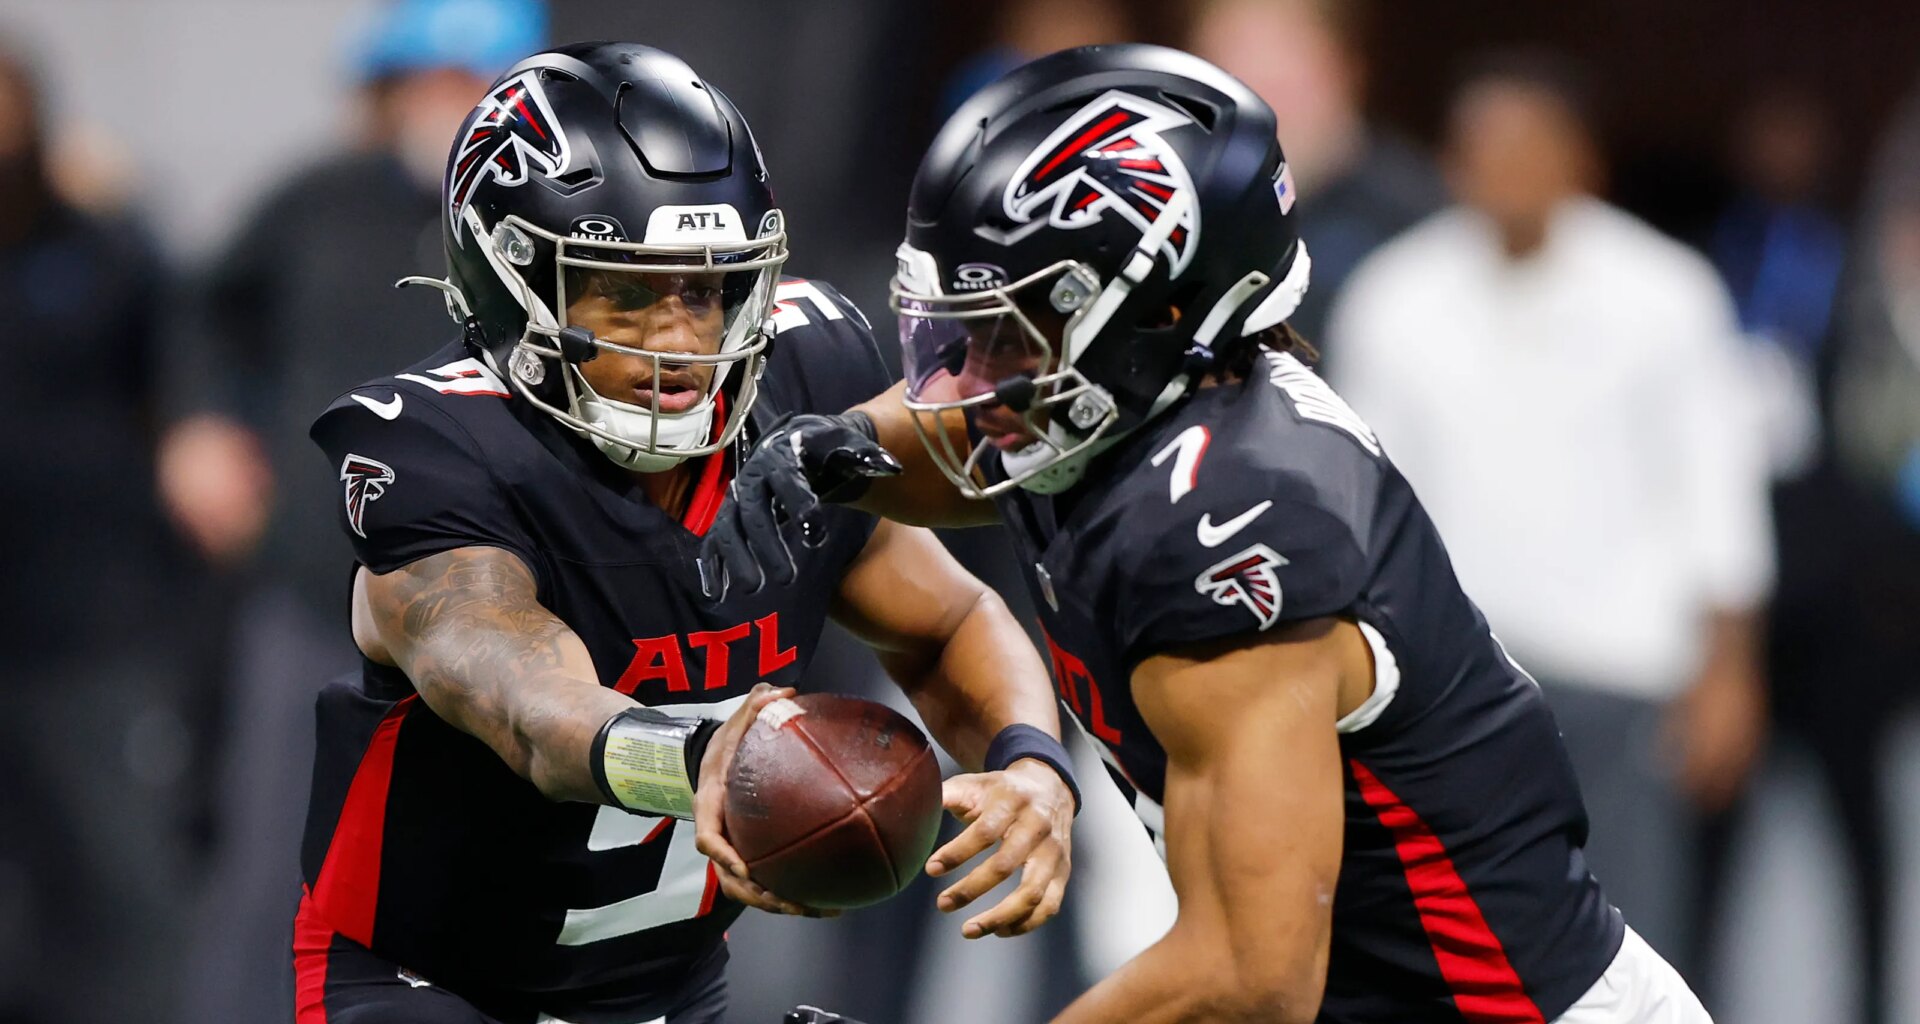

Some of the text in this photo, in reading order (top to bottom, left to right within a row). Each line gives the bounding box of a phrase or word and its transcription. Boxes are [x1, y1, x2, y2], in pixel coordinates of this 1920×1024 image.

[676, 212, 726, 229] ATL
[1150, 424, 1212, 504] 7
[613, 612, 797, 696] ATL
